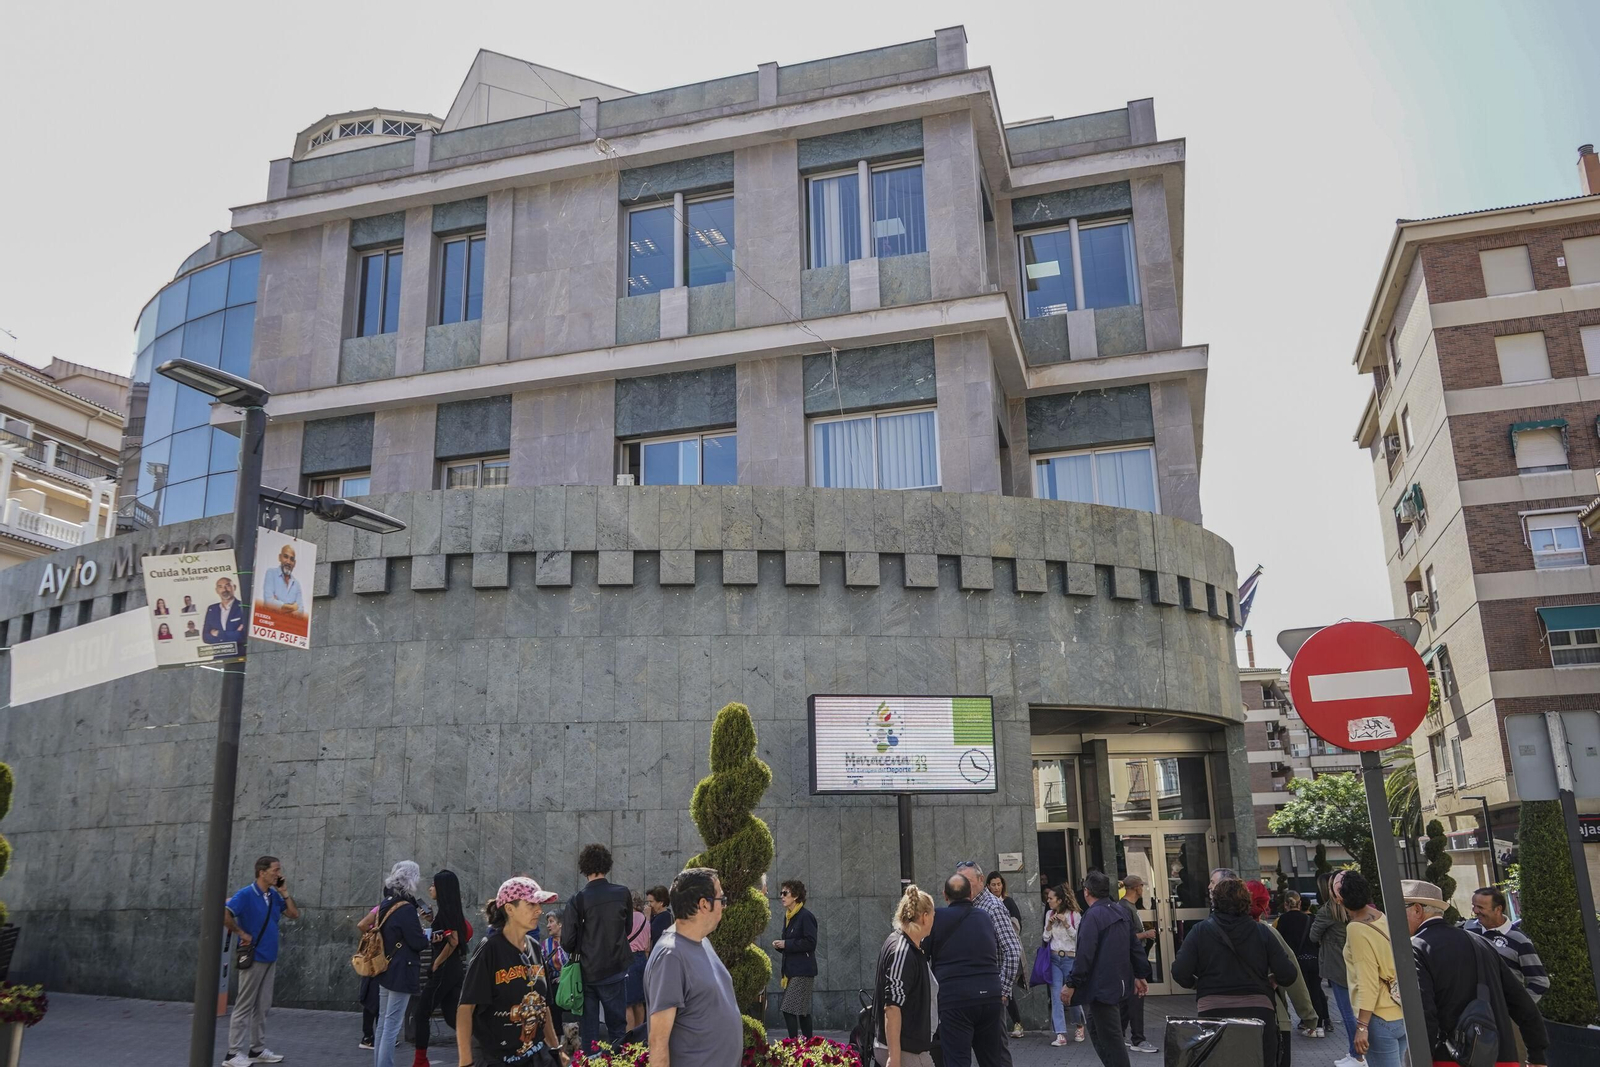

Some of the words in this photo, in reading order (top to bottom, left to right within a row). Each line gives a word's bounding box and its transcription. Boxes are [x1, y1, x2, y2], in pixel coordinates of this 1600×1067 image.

[178, 555, 200, 564] VOX
[38, 555, 97, 600] Ayto
[149, 568, 179, 579] Cuida
[181, 564, 232, 577] Maracena
[253, 626, 277, 640] VOTA
[886, 766, 911, 774] Deporte
